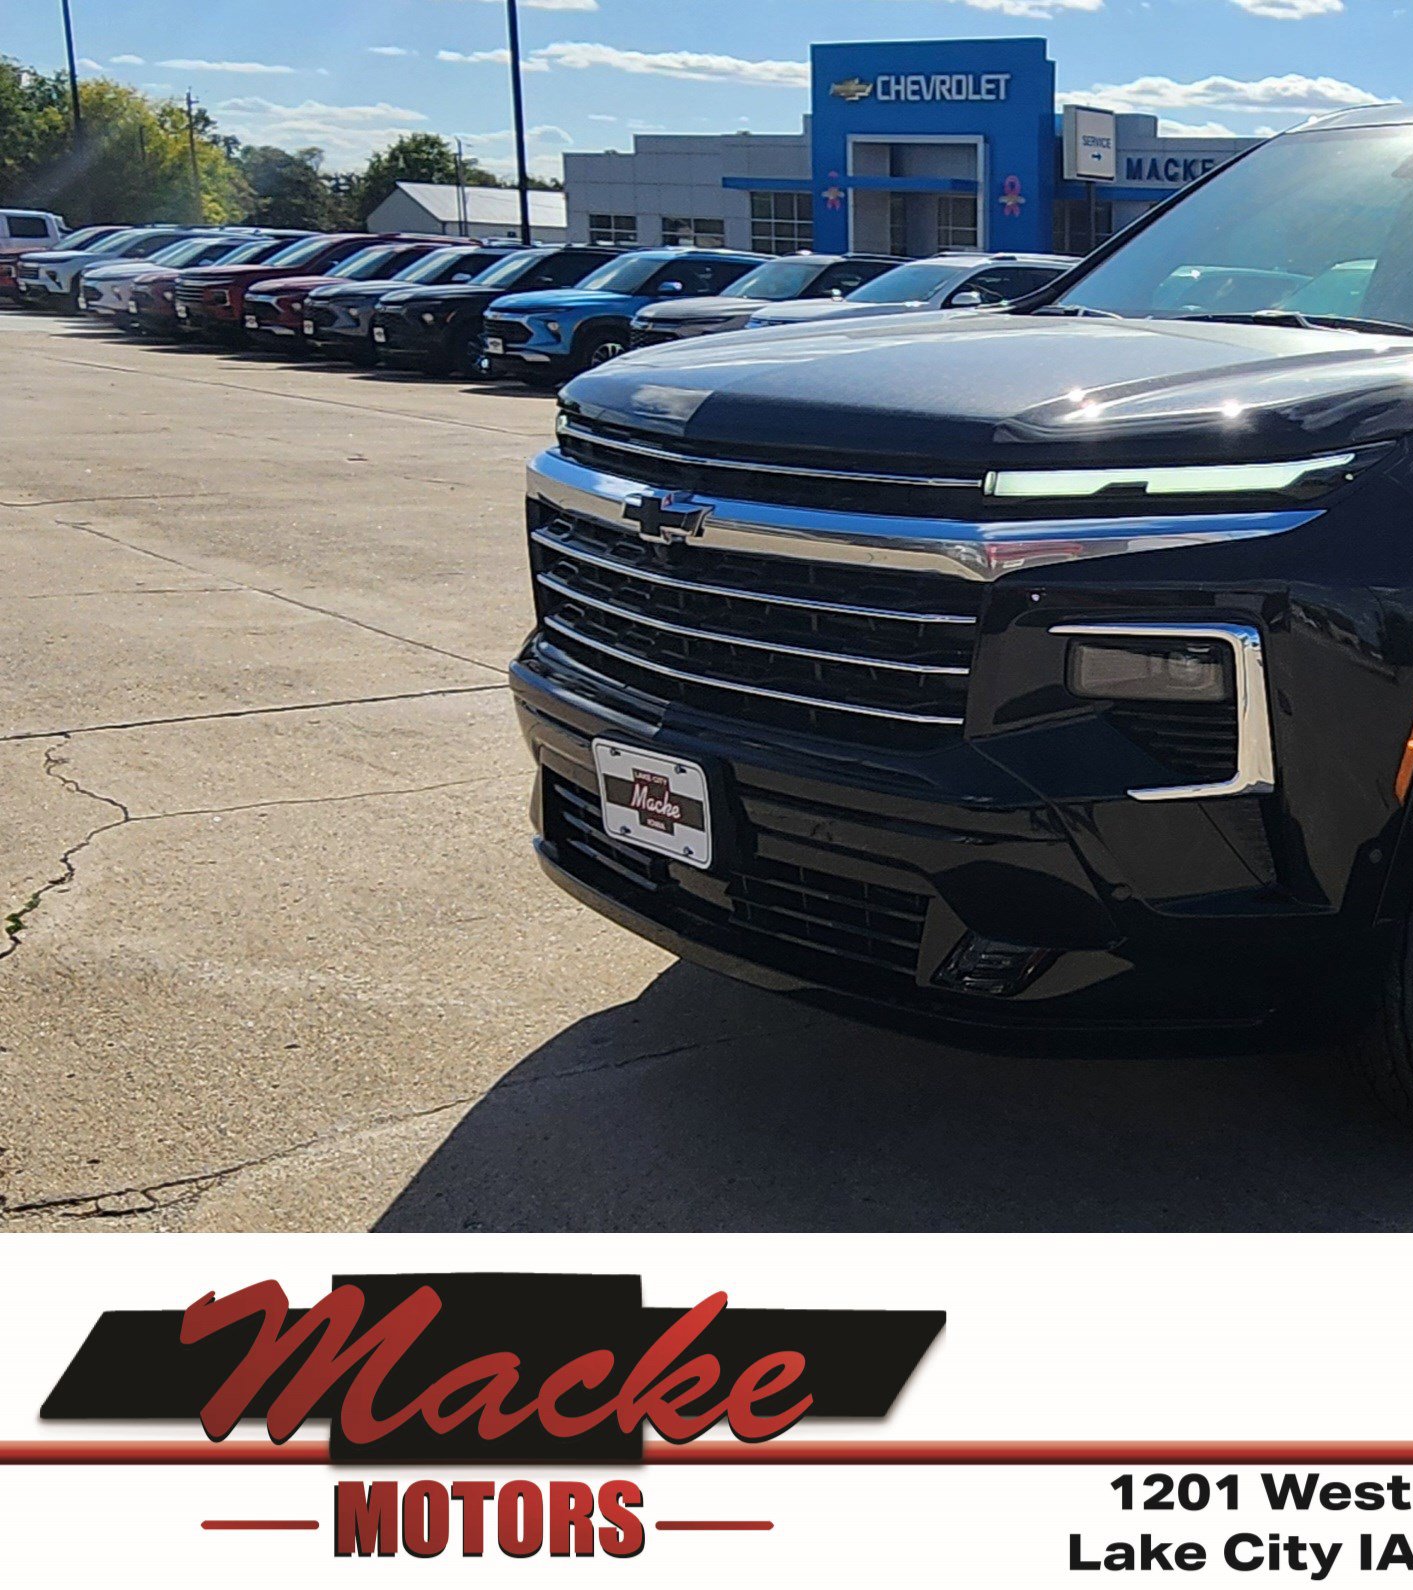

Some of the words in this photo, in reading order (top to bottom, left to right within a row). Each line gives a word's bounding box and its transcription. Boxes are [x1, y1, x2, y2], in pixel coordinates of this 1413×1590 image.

[876, 74, 1010, 101] CHEVROLET
[1082, 134, 1112, 149] SERVICE
[631, 783, 681, 819] Macke
